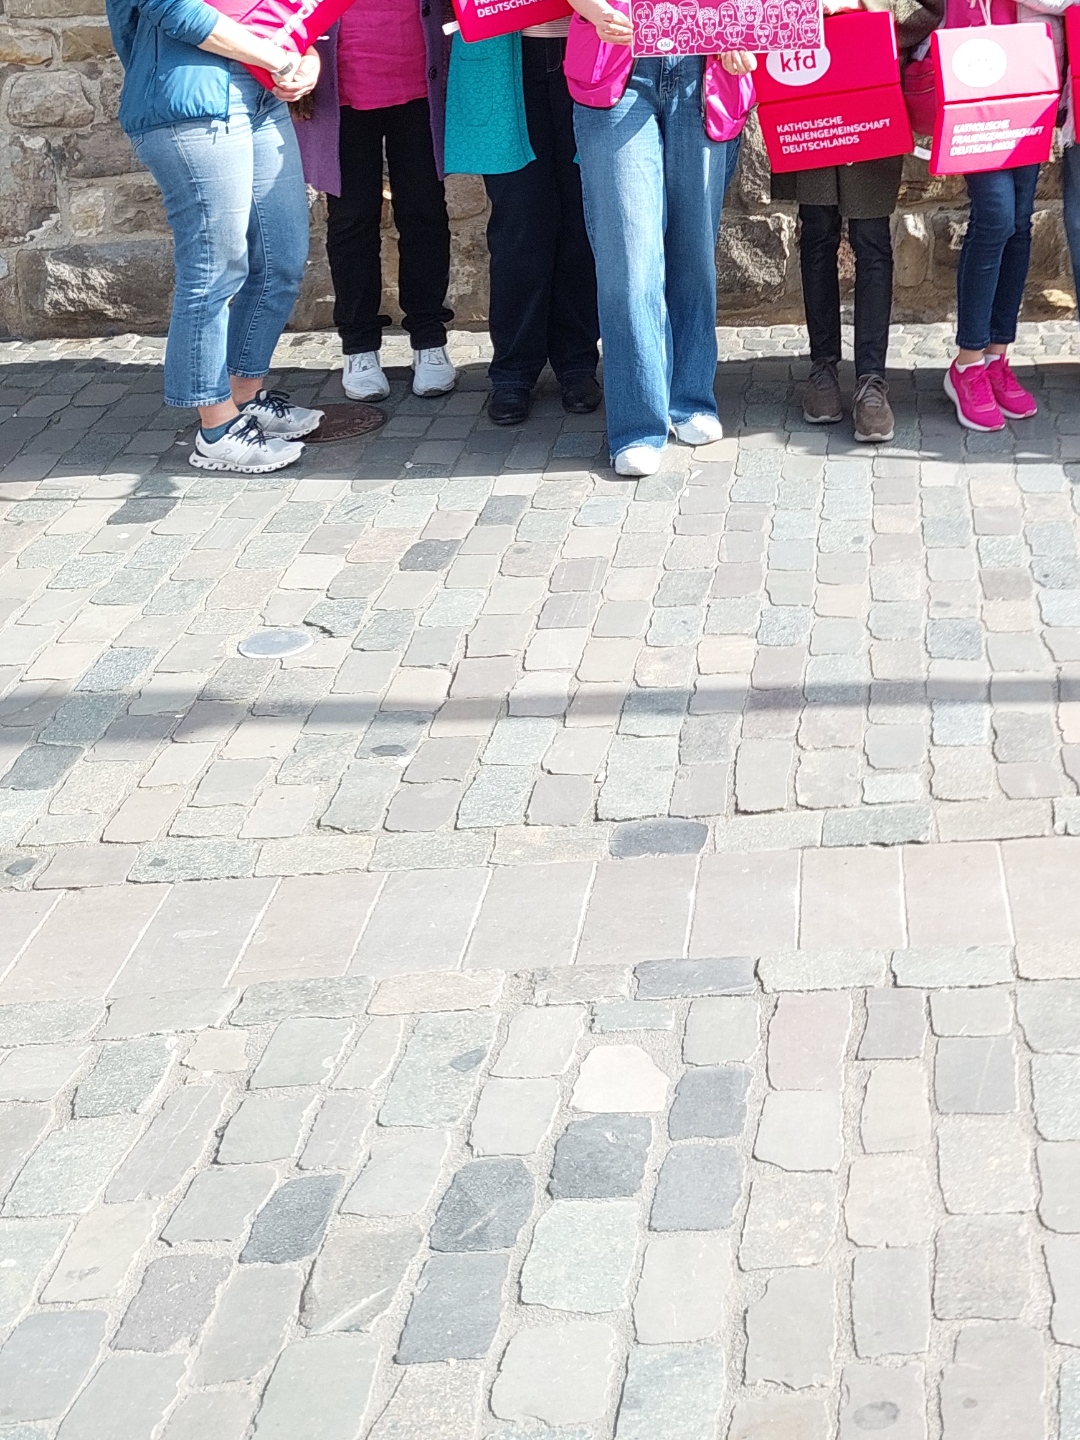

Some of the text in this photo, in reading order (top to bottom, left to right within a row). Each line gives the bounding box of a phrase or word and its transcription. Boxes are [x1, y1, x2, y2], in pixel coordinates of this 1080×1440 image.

[780, 50, 817, 74] kfd
[776, 115, 844, 133] KATHOLISCHE
[779, 118, 891, 144] FRAUENGEMEINSCHAFT
[952, 119, 1011, 135] KATHOLISCHE
[781, 134, 860, 155] DEUTSCHLANDS
[949, 139, 1016, 157] DEUTSCHLANDS
